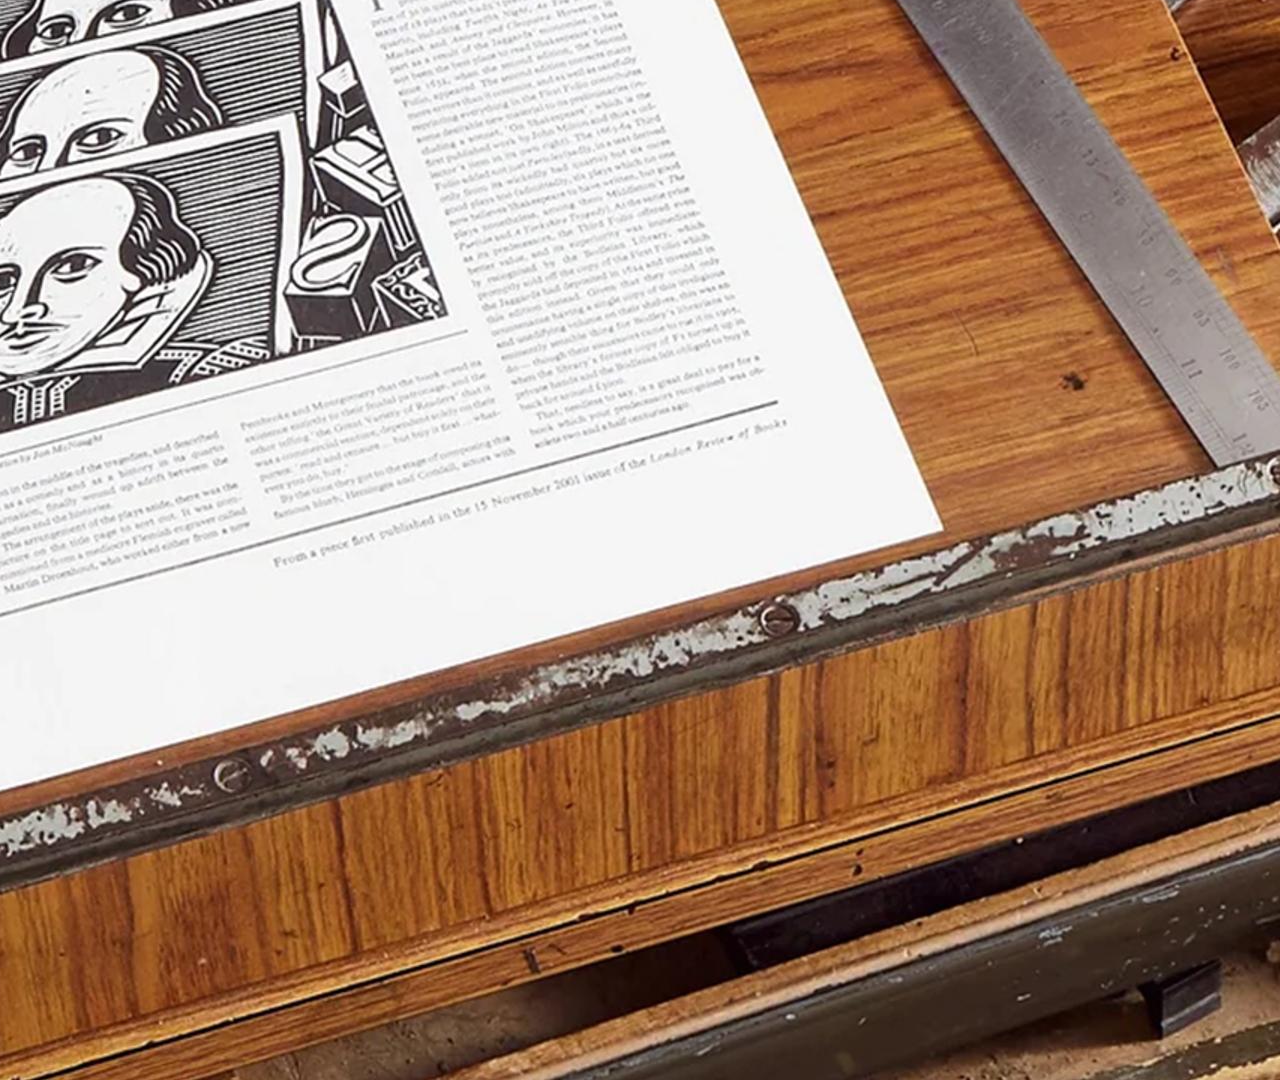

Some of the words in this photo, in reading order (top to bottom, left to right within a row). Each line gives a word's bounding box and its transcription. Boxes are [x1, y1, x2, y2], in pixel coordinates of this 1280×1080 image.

[656, 375, 682, 391] great
[272, 503, 312, 520] famous
[461, 454, 492, 469] actors
[493, 447, 517, 459] with
[272, 552, 308, 568] From
[319, 540, 349, 557] piece
[351, 532, 376, 547] first
[378, 514, 436, 540] published
[452, 506, 471, 518] the
[491, 484, 551, 507] November
[553, 474, 581, 490] 2001
[582, 468, 612, 483] issue
[623, 458, 647, 470] the
[649, 445, 692, 463] London
[696, 434, 734, 451] Review
[754, 419, 788, 435] Books
[0, 540, 23, 553] The
[23, 522, 87, 547] arrangement
[117, 507, 145, 523] plays
[174, 492, 201, 506] there
[2, 578, 41, 595] Martin
[122, 543, 161, 561] worked
[160, 537, 191, 552] either
[192, 529, 220, 544] from
